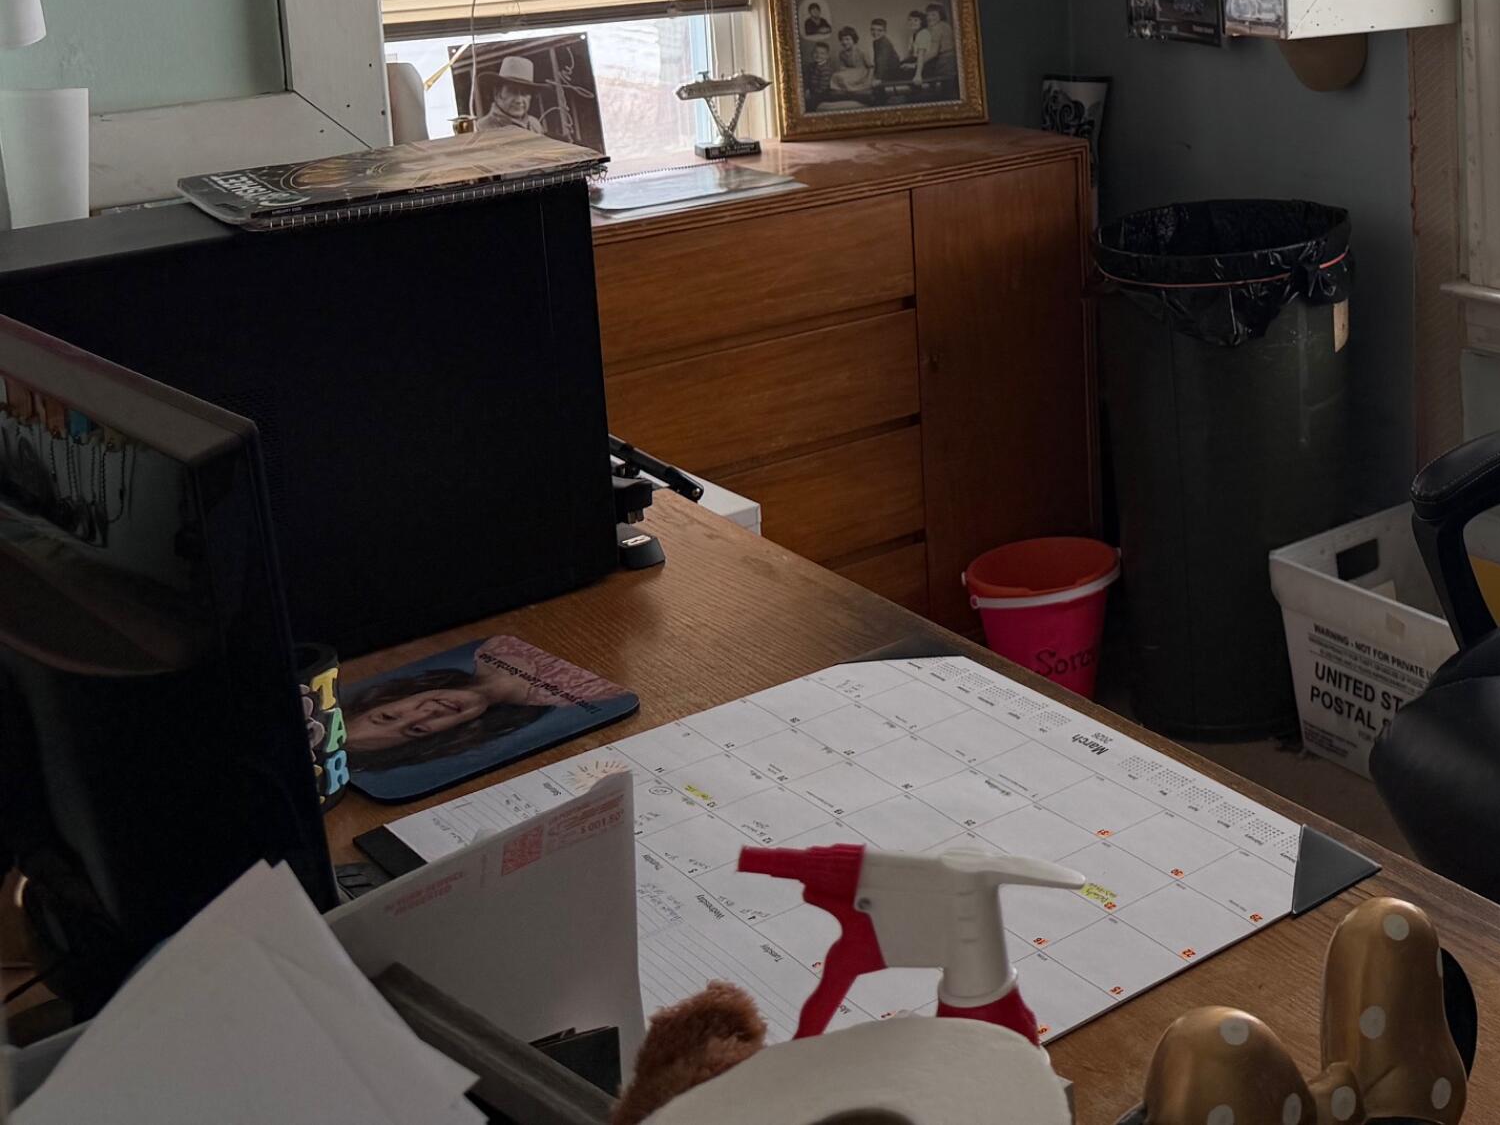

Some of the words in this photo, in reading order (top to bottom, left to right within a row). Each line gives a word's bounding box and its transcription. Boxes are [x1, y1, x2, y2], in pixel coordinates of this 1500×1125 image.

[1314, 624, 1349, 646] WARNING
[1355, 641, 1371, 654] NOT
[1373, 649, 1389, 661] FOR
[1392, 656, 1424, 677] PRIVATE
[1315, 662, 1375, 702] UNITED
[1310, 686, 1376, 730] POSTAL
[1071, 733, 1109, 756] March
[1097, 828, 1111, 837] 31
[1170, 868, 1184, 878] 30
[695, 894, 725, 920] Wednesday
[1104, 901, 1116, 910] 23
[1249, 913, 1263, 923] 29
[1033, 936, 1048, 946] 16
[760, 943, 784, 963] Tuesday
[1182, 948, 1196, 958] 22
[1109, 985, 1124, 996] 15
